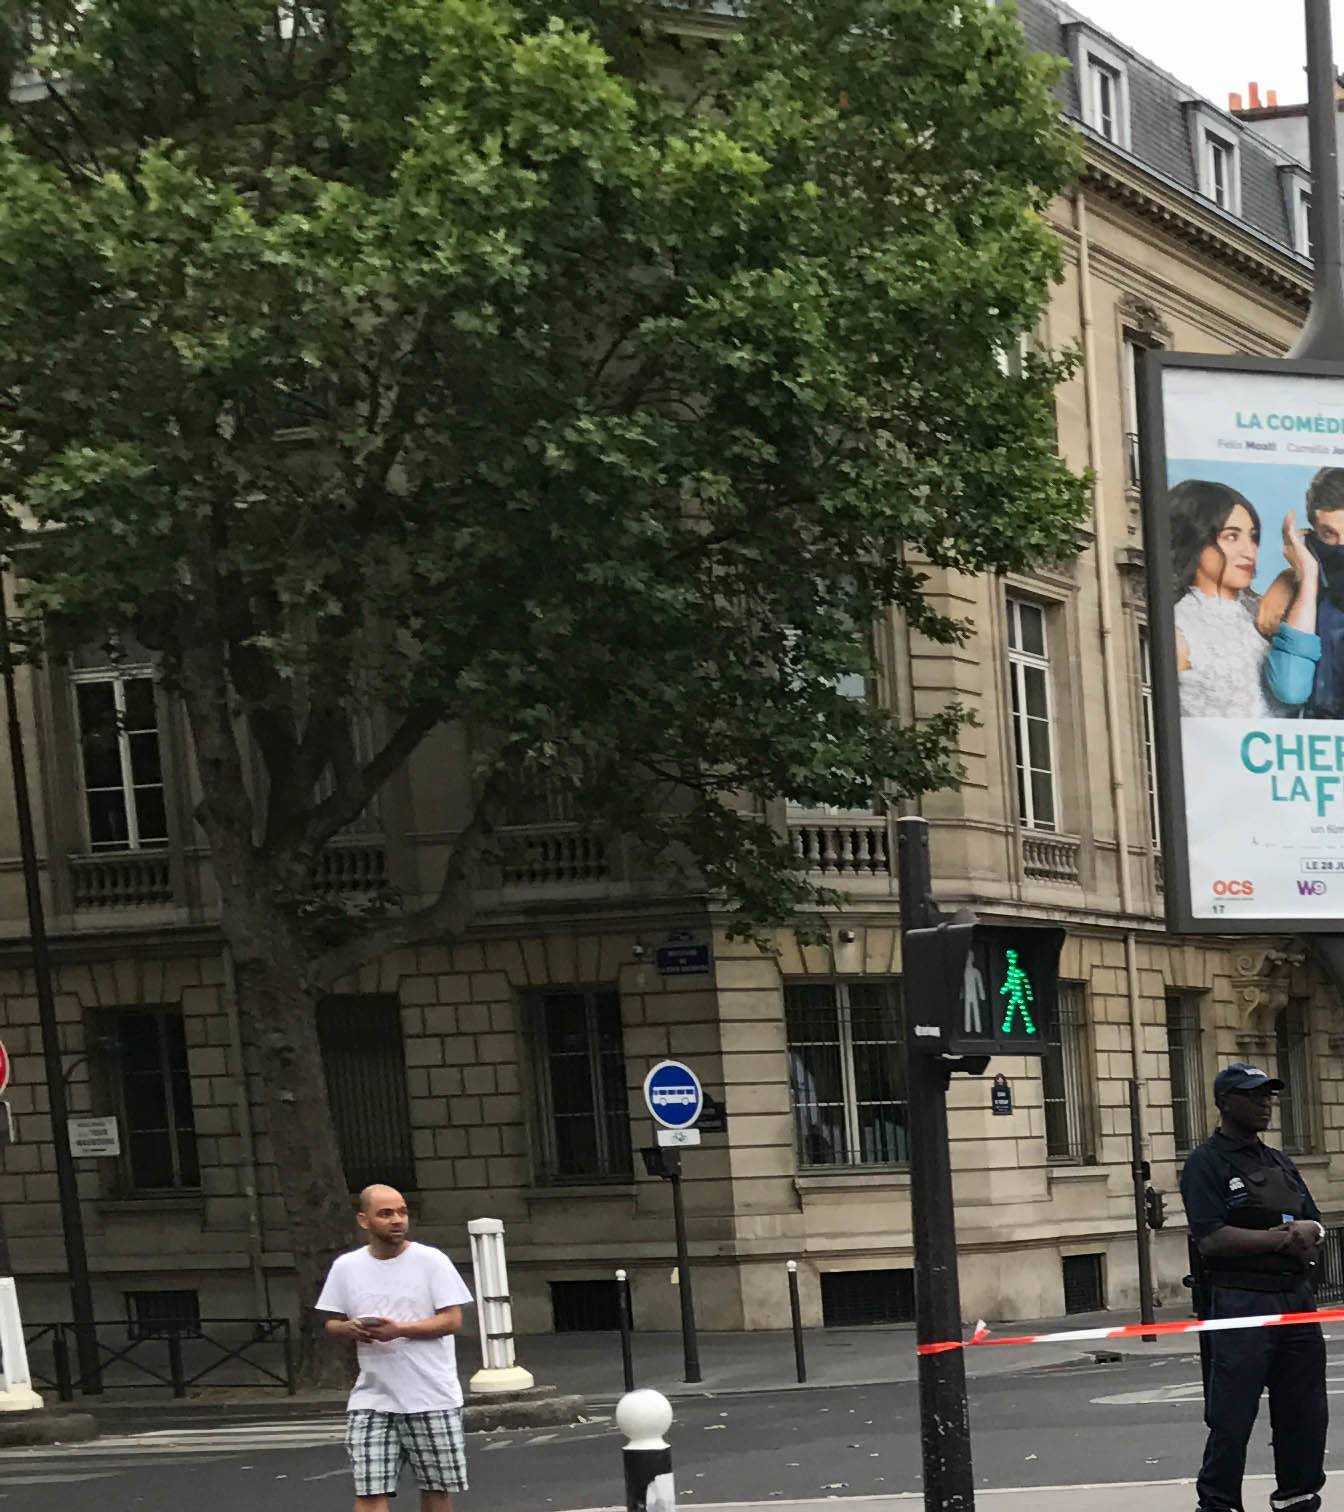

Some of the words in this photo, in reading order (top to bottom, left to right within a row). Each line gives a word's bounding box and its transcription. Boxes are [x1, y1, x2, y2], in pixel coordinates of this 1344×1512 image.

[1235, 411, 1262, 430] LA
[1271, 775, 1311, 803] LA
[1306, 861, 1319, 871] LE
[1212, 880, 1254, 896] OCS
